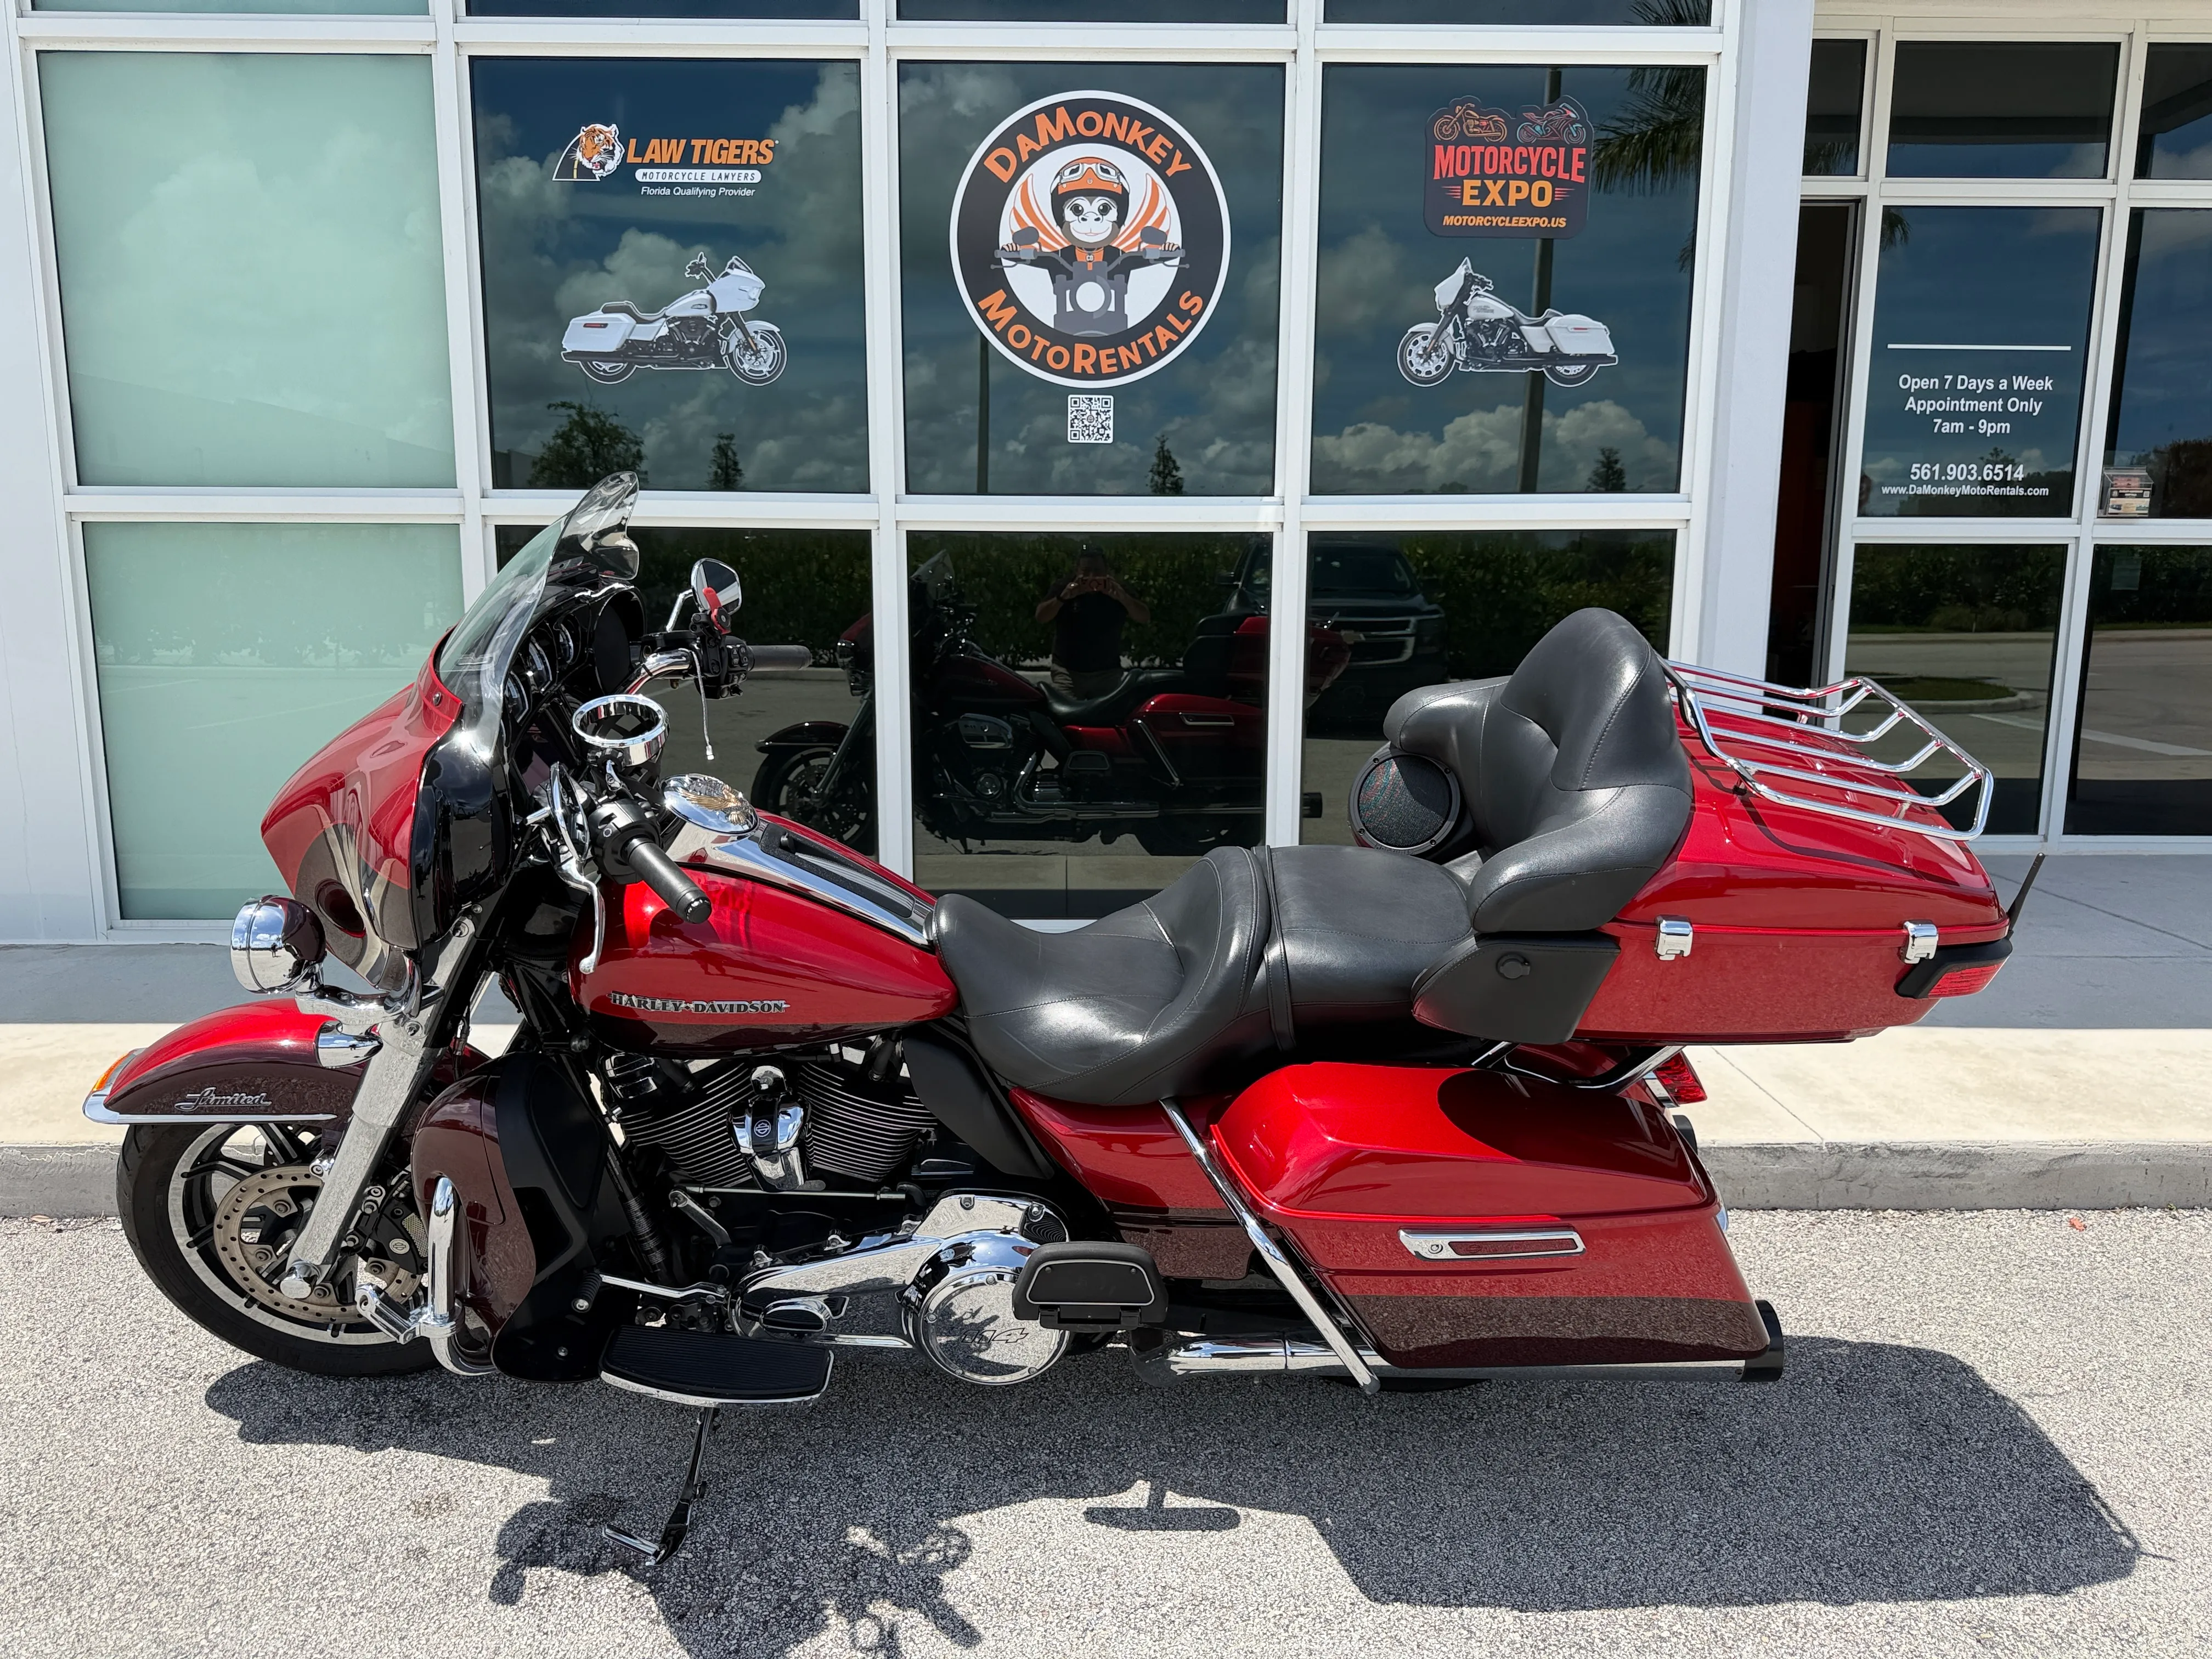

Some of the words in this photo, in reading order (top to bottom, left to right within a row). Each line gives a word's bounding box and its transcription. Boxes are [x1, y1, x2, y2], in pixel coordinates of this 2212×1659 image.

[626, 138, 686, 163] LAW
[691, 139, 774, 165] TIGERS
[1433, 145, 1586, 183] MOTORCYCLE
[641, 172, 706, 180] MOTORCYCLE
[712, 172, 756, 181] LAWYERS
[641, 187, 670, 195] Florida
[673, 187, 716, 198] Qualifying
[719, 188, 755, 196] Provider
[1462, 179, 1553, 207] EXPO
[1443, 215, 1567, 228] MOTORCYCLEEXPO.US
[1899, 374, 1939, 392] Open
[1944, 375, 1953, 390] 7
[1957, 375, 1994, 393] Days
[1999, 379, 2007, 390] a
[2012, 375, 2053, 391] Week
[1904, 396, 2004, 414] Appointment
[2007, 397, 2043, 416] Only
[1933, 419, 1964, 433] 7am
[1978, 419, 2010, 437] 9pm
[1910, 463, 2024, 482] 561.903.6514
[1881, 485, 2049, 498] www.DaMonkeyMotoRentals.com
[174, 1087, 272, 1112] Limited
[961, 1328, 1029, 1344] 114
